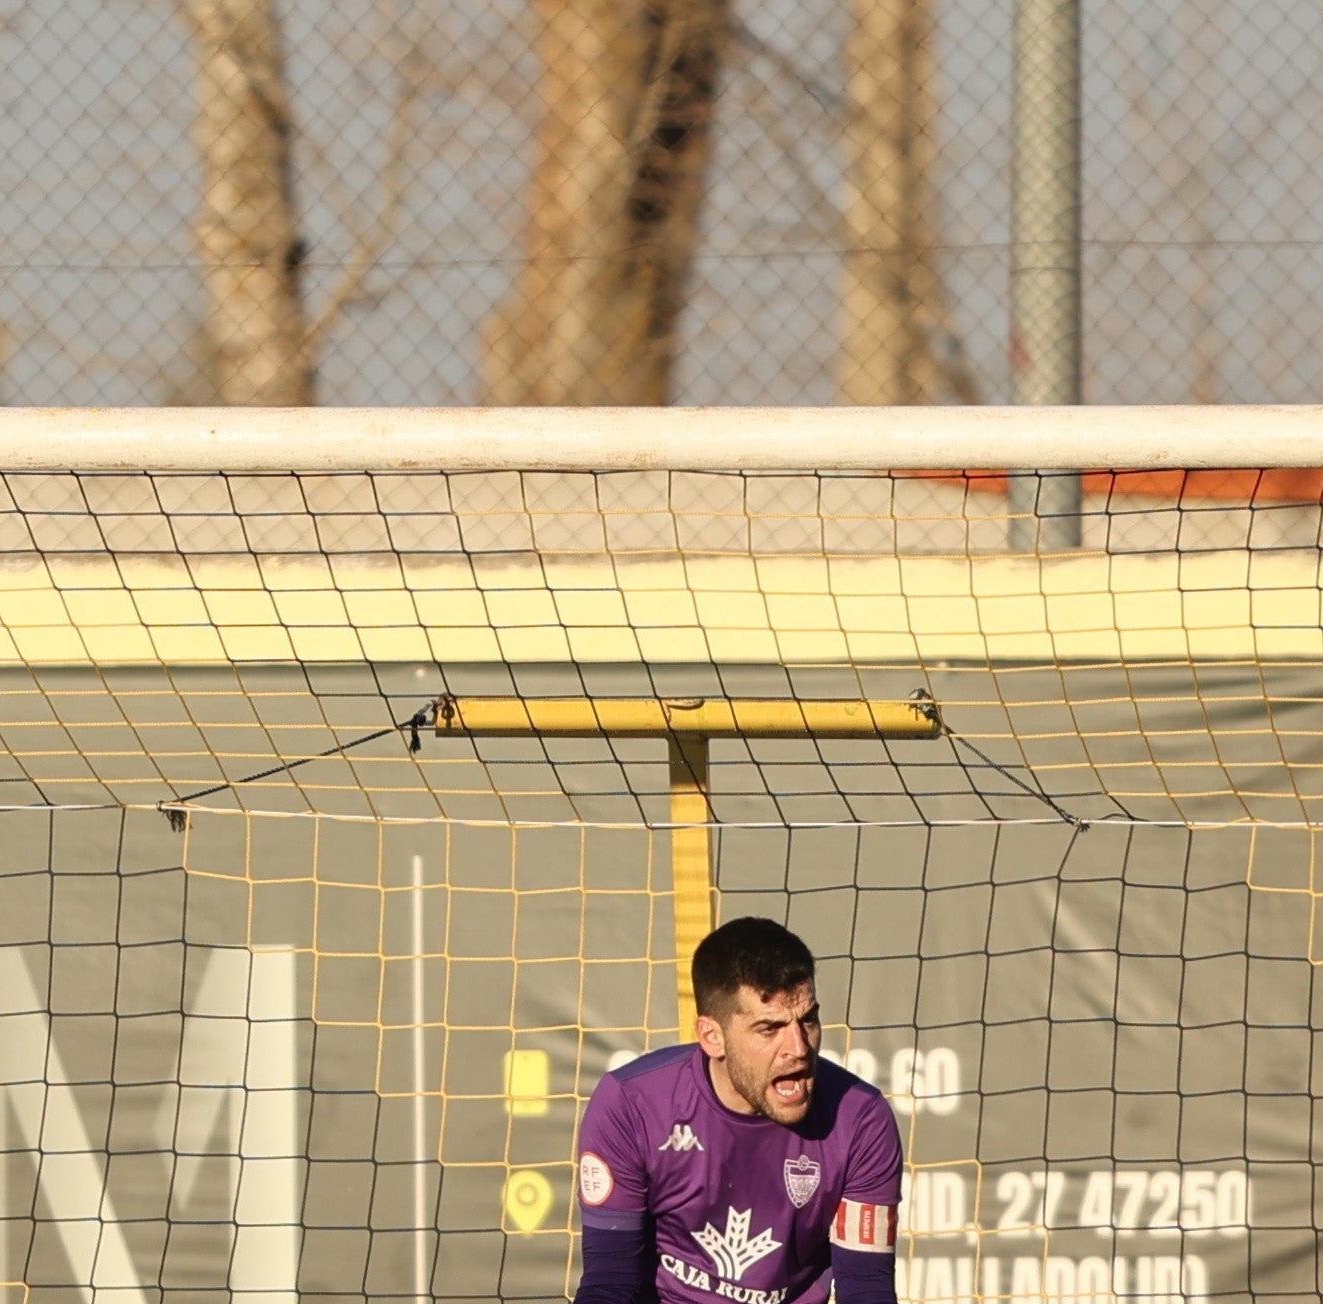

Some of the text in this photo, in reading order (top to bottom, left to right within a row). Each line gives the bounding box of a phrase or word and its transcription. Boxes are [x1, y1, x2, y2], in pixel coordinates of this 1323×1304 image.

[891, 1047, 961, 1116] 60
[996, 1170, 1066, 1239] 27
[1079, 1170, 1254, 1239] 47250
[660, 1254, 712, 1291] CAJA
